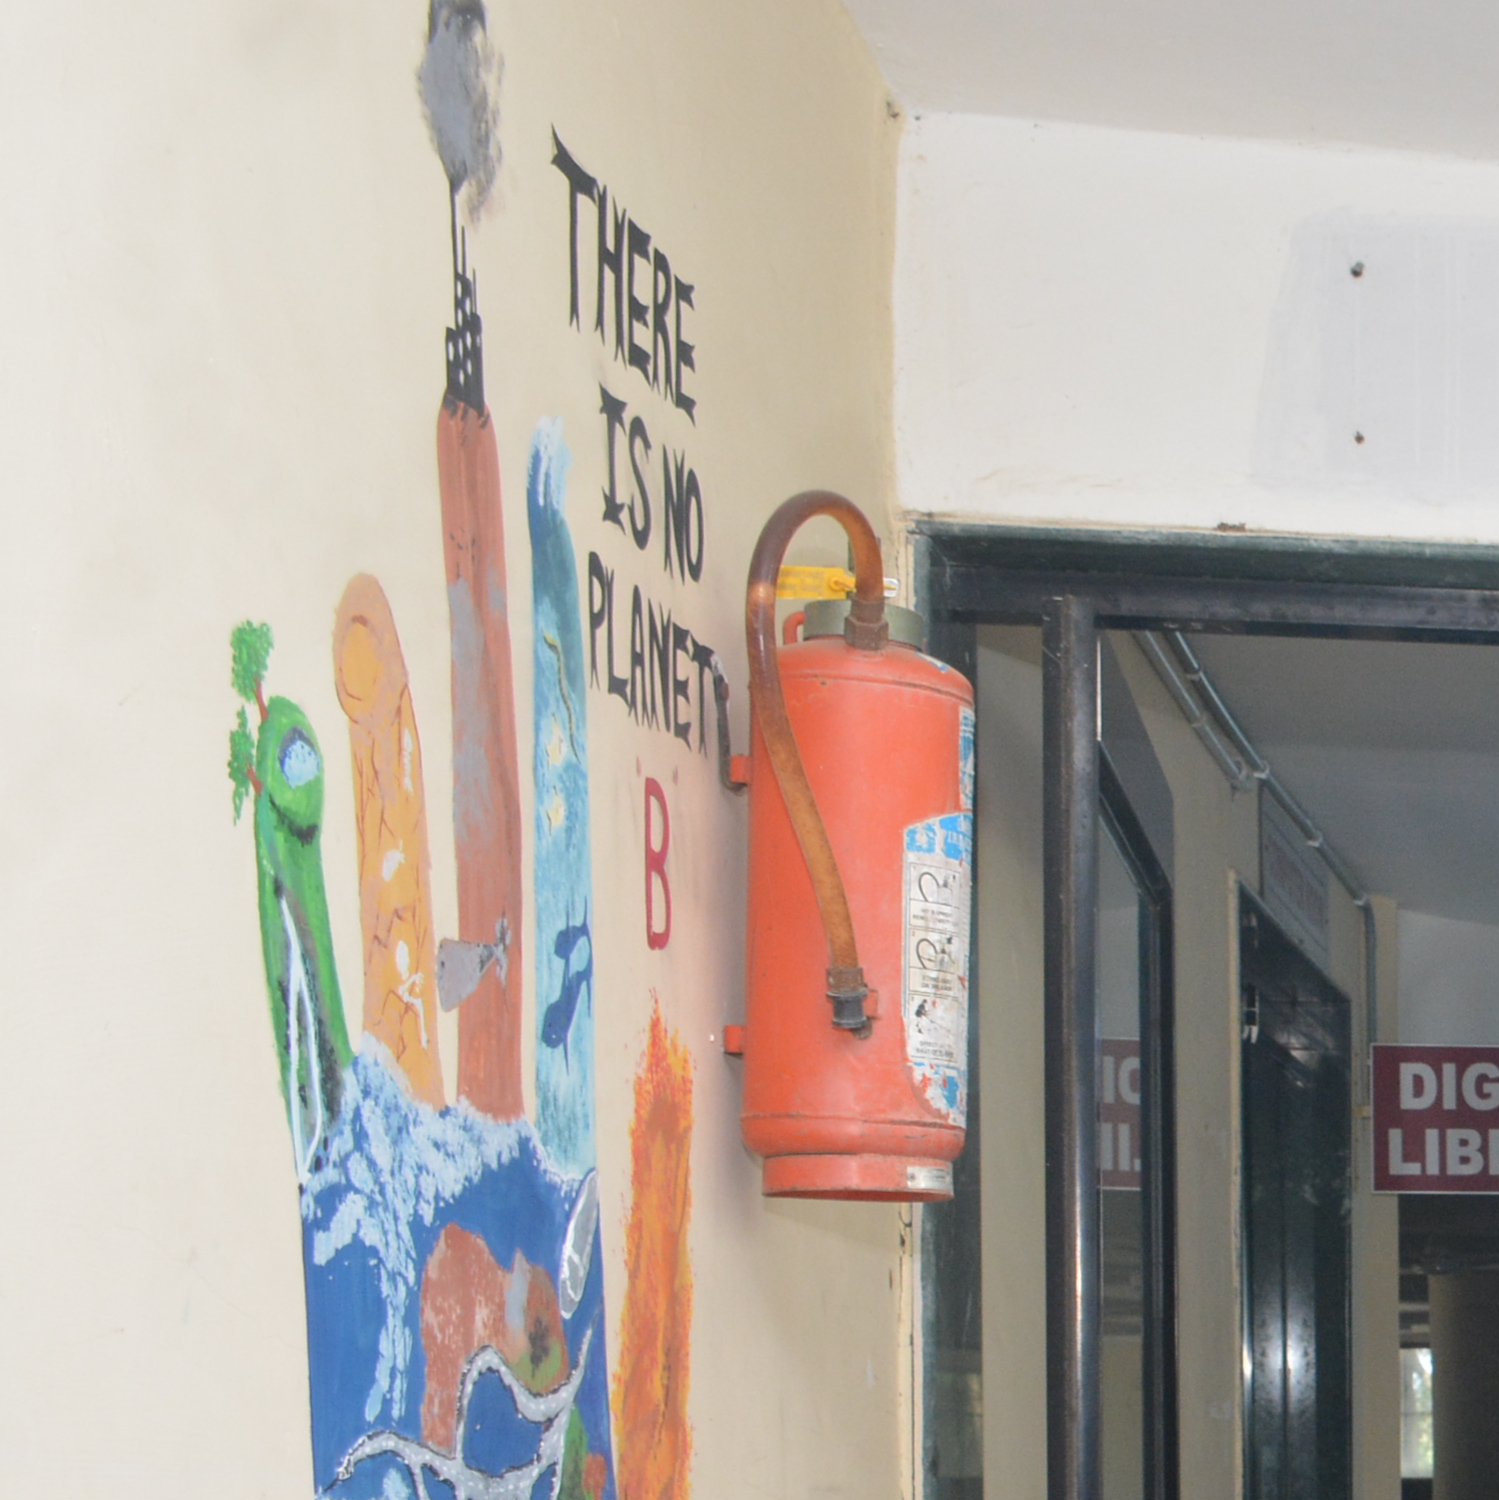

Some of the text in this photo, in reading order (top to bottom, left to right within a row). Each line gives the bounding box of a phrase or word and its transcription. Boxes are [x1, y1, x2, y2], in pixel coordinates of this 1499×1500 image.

[551, 122, 697, 428] THERE
[599, 381, 704, 586] IS NO
[588, 550, 717, 759] PLANET
[645, 776, 672, 951] B
